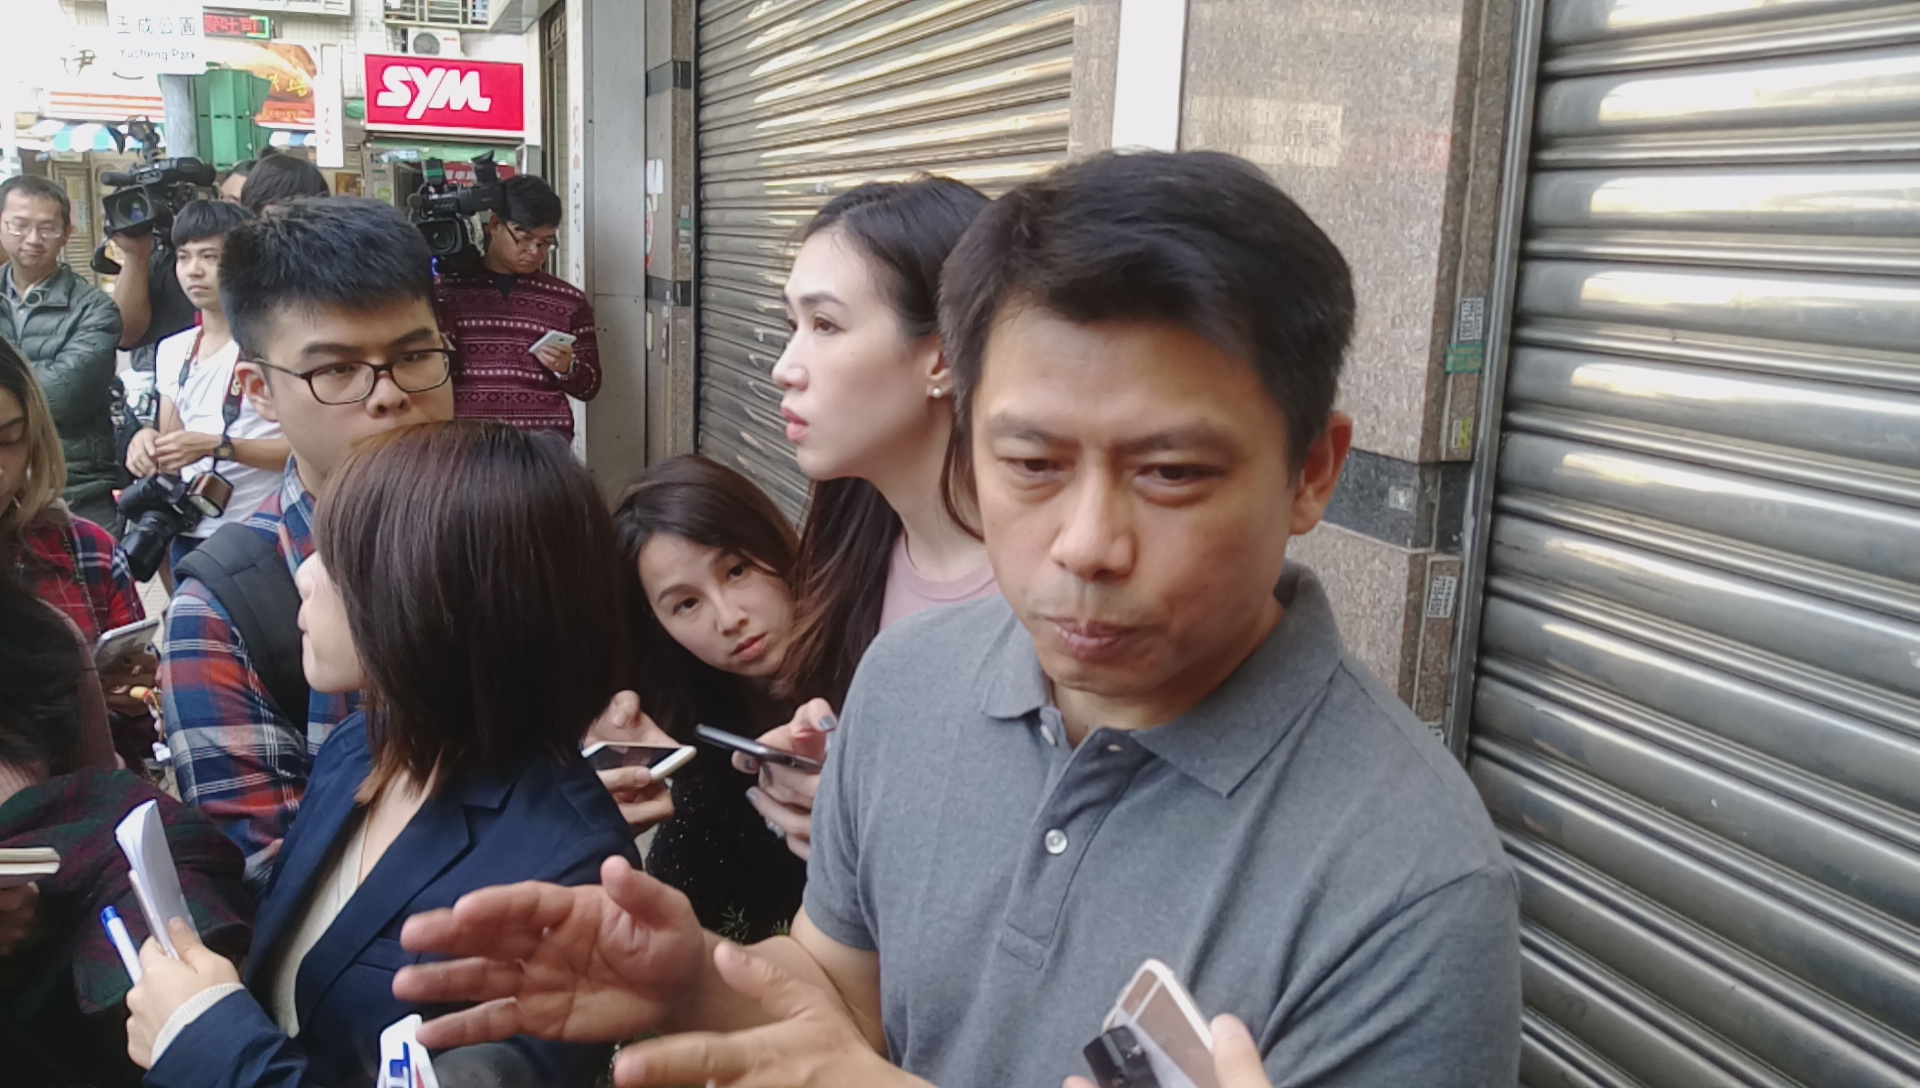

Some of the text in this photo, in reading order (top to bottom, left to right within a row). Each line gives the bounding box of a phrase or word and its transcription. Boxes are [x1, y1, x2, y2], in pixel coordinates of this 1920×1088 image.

[119, 48, 195, 62] Yucheng Park
[377, 66, 491, 119] SYM
